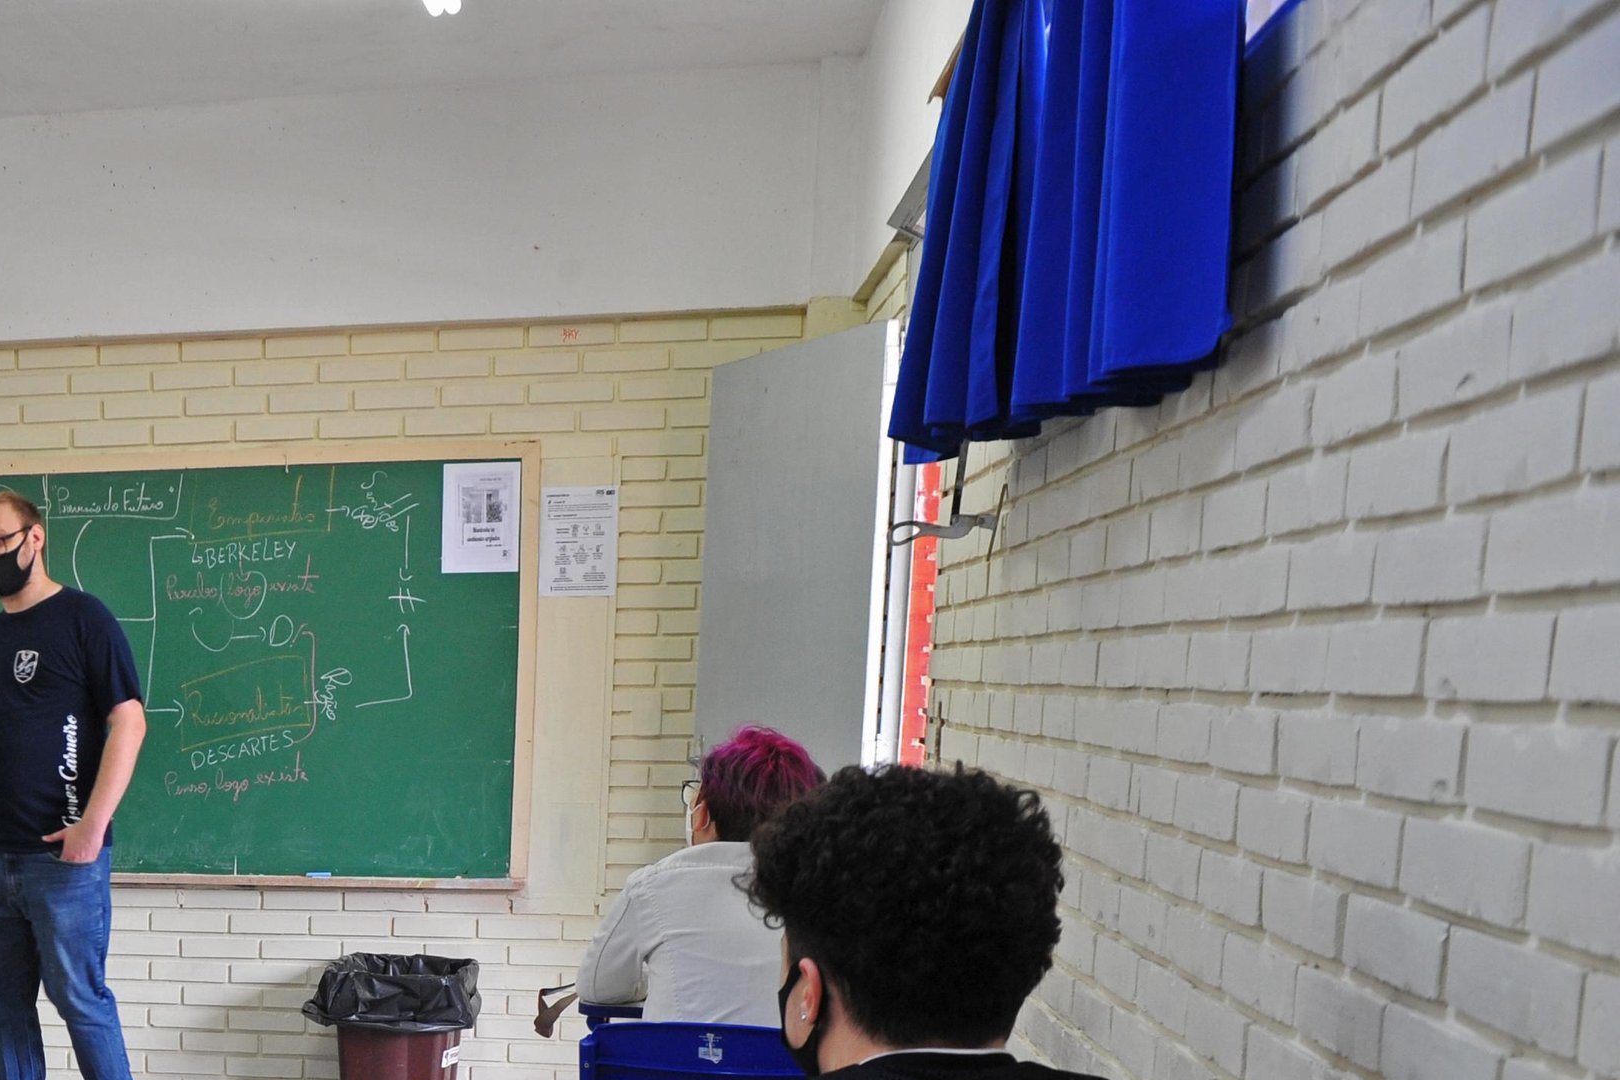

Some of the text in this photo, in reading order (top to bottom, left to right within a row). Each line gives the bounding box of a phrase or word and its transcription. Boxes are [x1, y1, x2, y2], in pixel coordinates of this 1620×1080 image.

[103, 486, 118, 512] do
[206, 538, 296, 568] BERKELEY
[227, 572, 262, 608] logo
[58, 714, 78, 782] Carneiro
[191, 730, 294, 770] DESCARTES
[215, 768, 249, 801] logo
